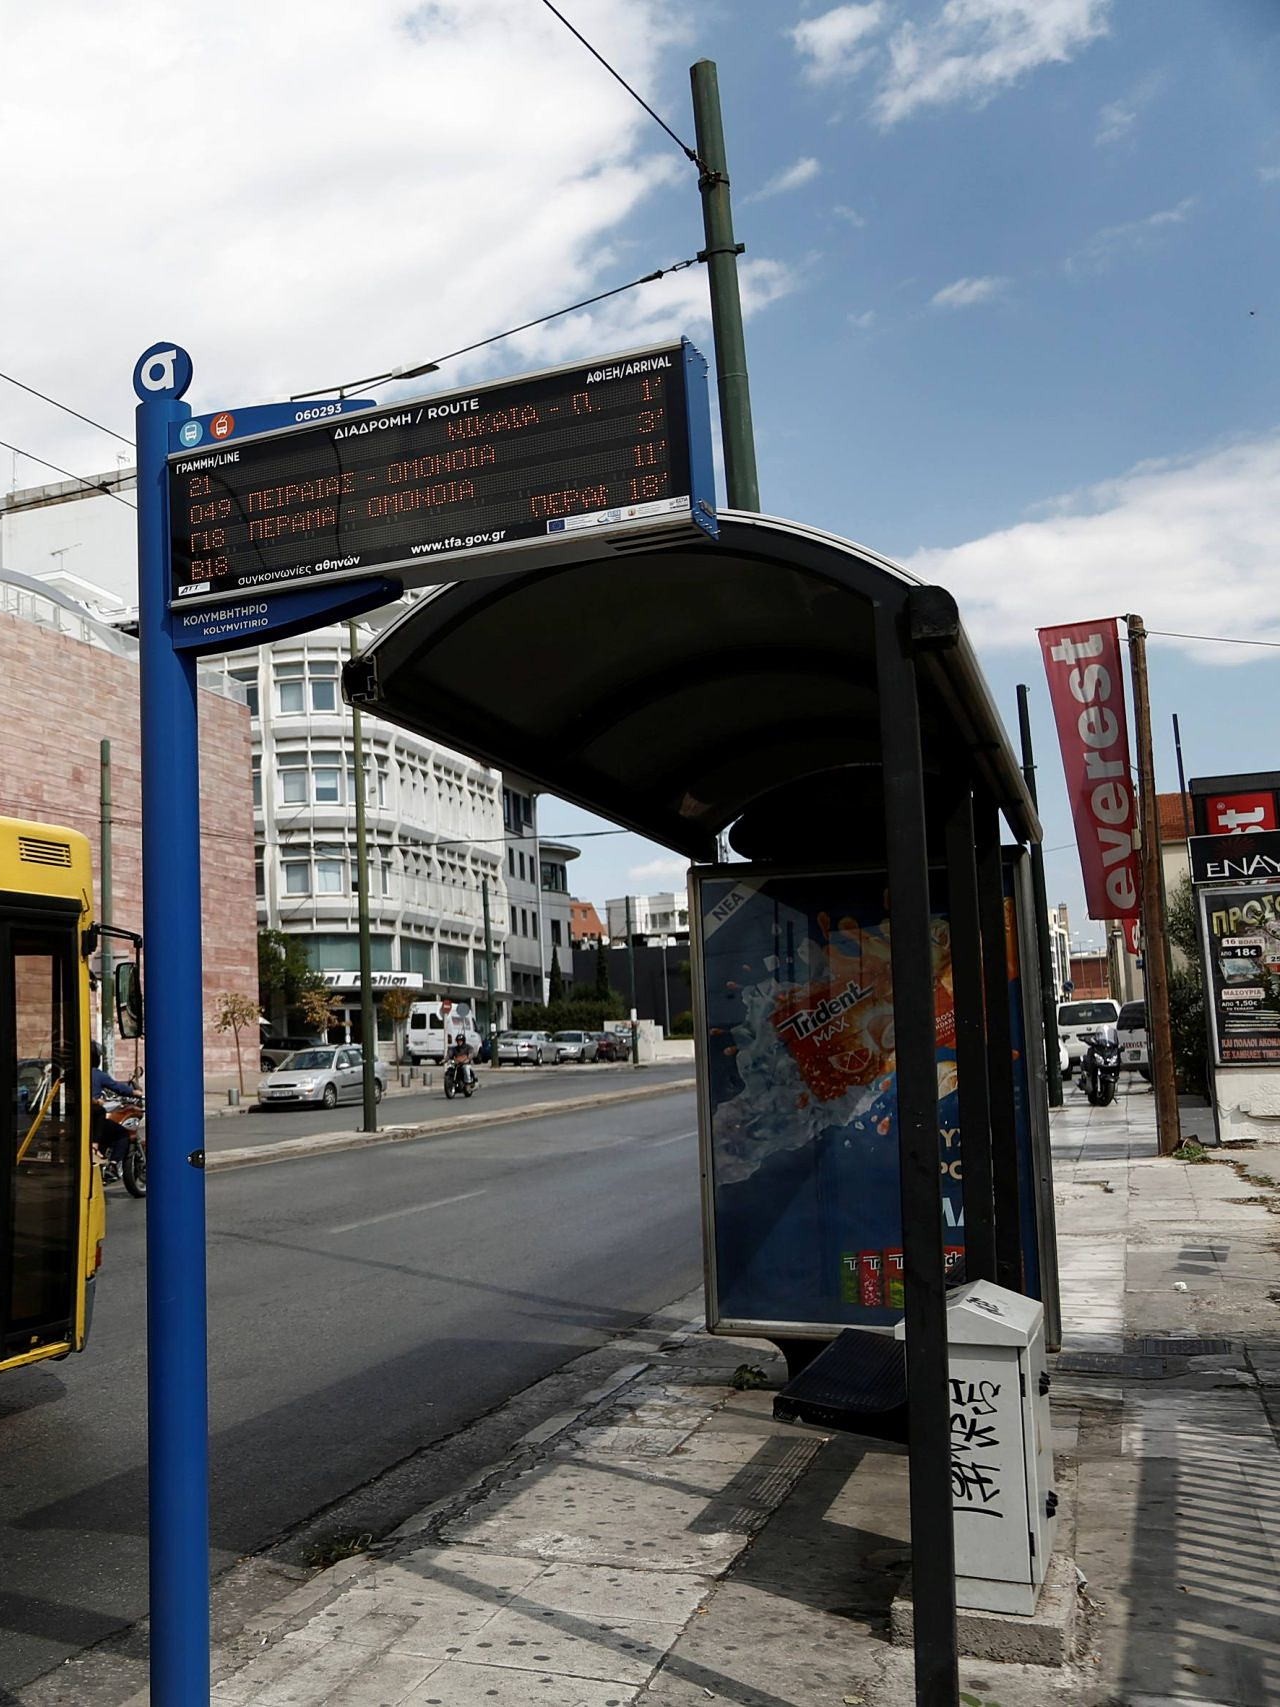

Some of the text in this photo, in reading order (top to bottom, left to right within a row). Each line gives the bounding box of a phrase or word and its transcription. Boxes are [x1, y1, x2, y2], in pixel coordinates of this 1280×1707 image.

[586, 355, 672, 384] ΑΦΙΞΗ/ARRIVAL
[295, 403, 342, 422] 060293
[334, 413, 412, 440] ΔΙΑΔΡΟΜΗ
[428, 398, 480, 419] ROUTE
[176, 451, 240, 474] ΓΡΑΜΜΗ/LINE
[189, 475, 212, 497] 21
[248, 472, 355, 512] ΠΕΙΡΑΙΑΣ
[387, 444, 495, 484] ΟΜΟΝΟΙΑ
[249, 506, 336, 541] ΠΕΡΑΜΑ
[368, 479, 474, 518] ΟΜΟΝΟΙΑ
[411, 529, 506, 555] www.tfa.gov.gr
[238, 555, 361, 586] συγκοινωνίες αθηνών
[183, 603, 269, 626] ΚΟΛΥΜΒΗΤΗΡΙΟ
[203, 618, 269, 635] KOLYMVITIRIO
[1050, 633, 1137, 910] everest
[1235, 948, 1257, 957] 18€
[353, 974, 407, 985] Fshion
[776, 981, 874, 1040] Trident
[812, 1016, 850, 1047] MAX
